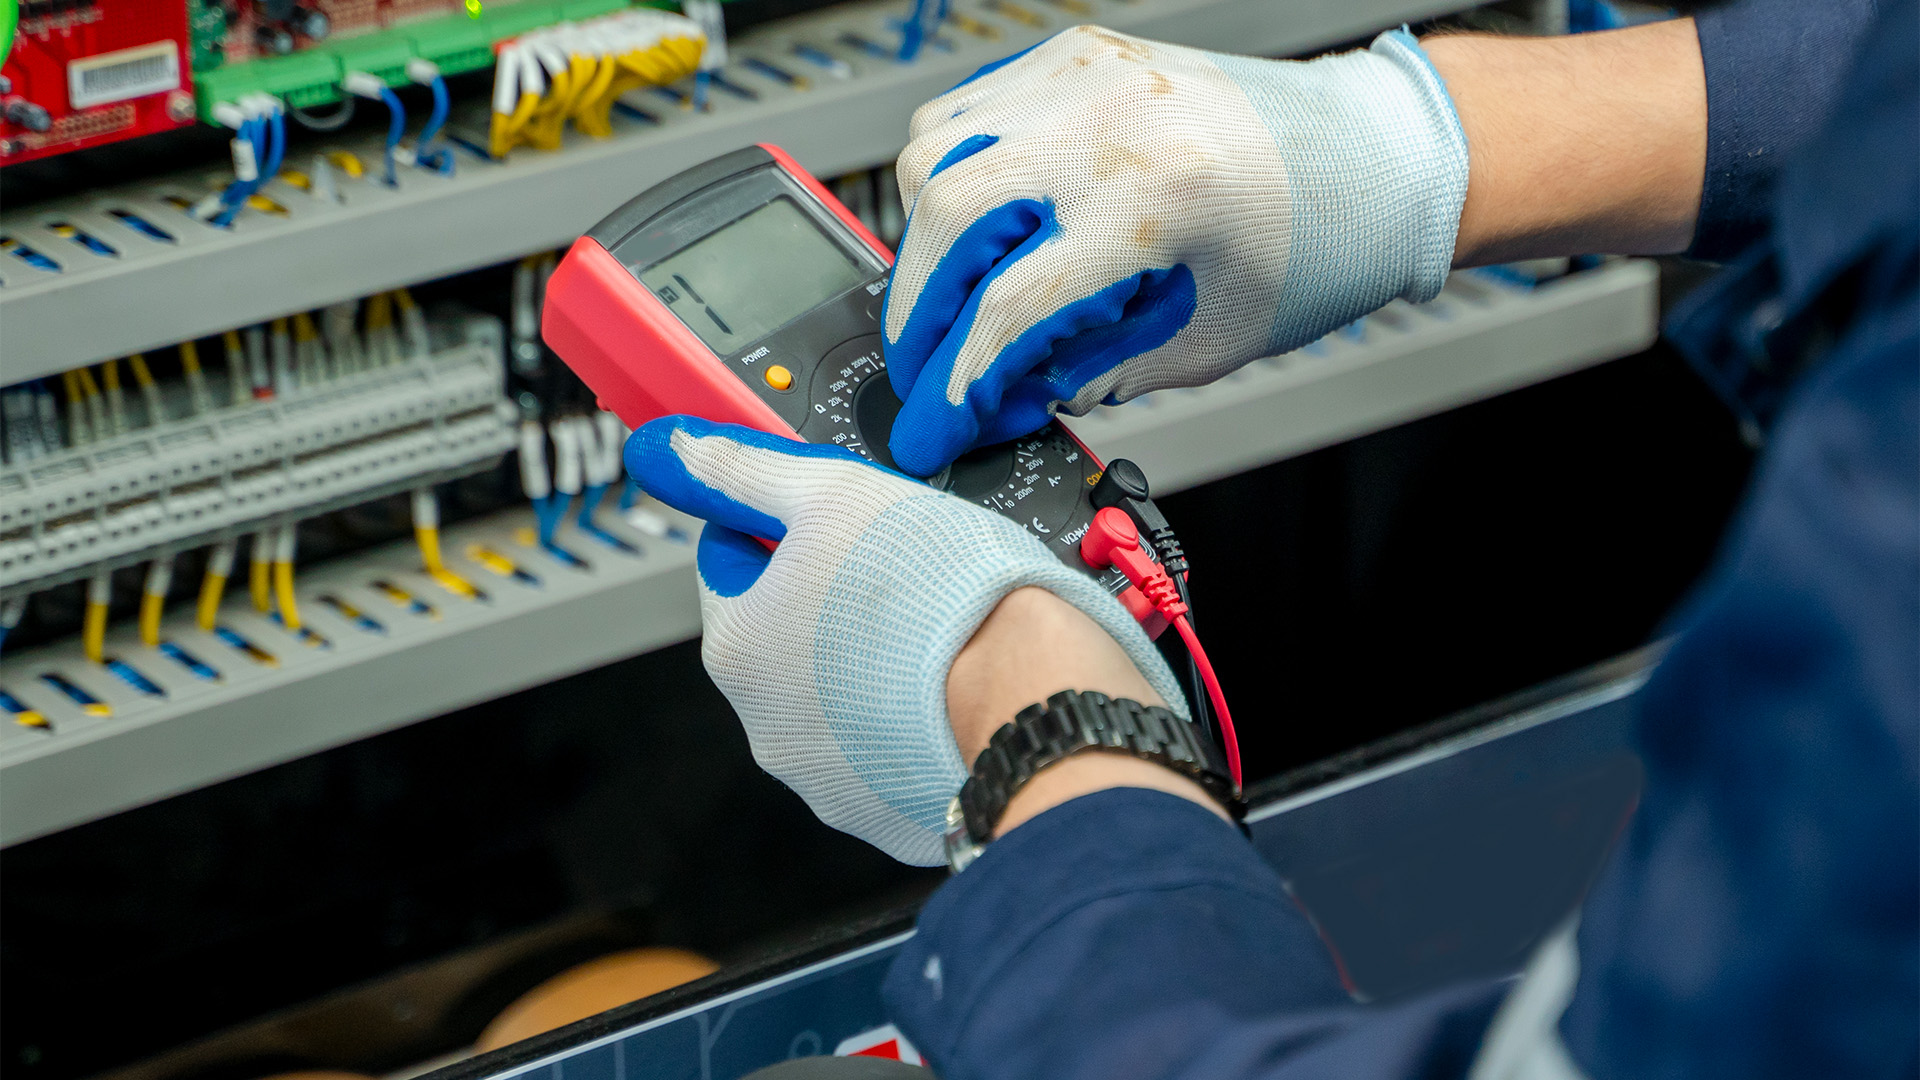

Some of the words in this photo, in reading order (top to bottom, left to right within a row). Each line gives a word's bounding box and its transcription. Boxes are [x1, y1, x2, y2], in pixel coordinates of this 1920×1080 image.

[741, 346, 770, 365] POWER
[851, 356, 868, 369] 200M
[840, 367, 854, 378] 2M
[829, 380, 848, 393] 200k
[827, 396, 843, 407] 20k
[832, 432, 847, 444] 200
[1026, 440, 1043, 452] hFE
[1066, 452, 1078, 464] PNP
[1023, 473, 1040, 485] 20m
[1014, 486, 1034, 501] 200m
[1004, 499, 1015, 509] 10
